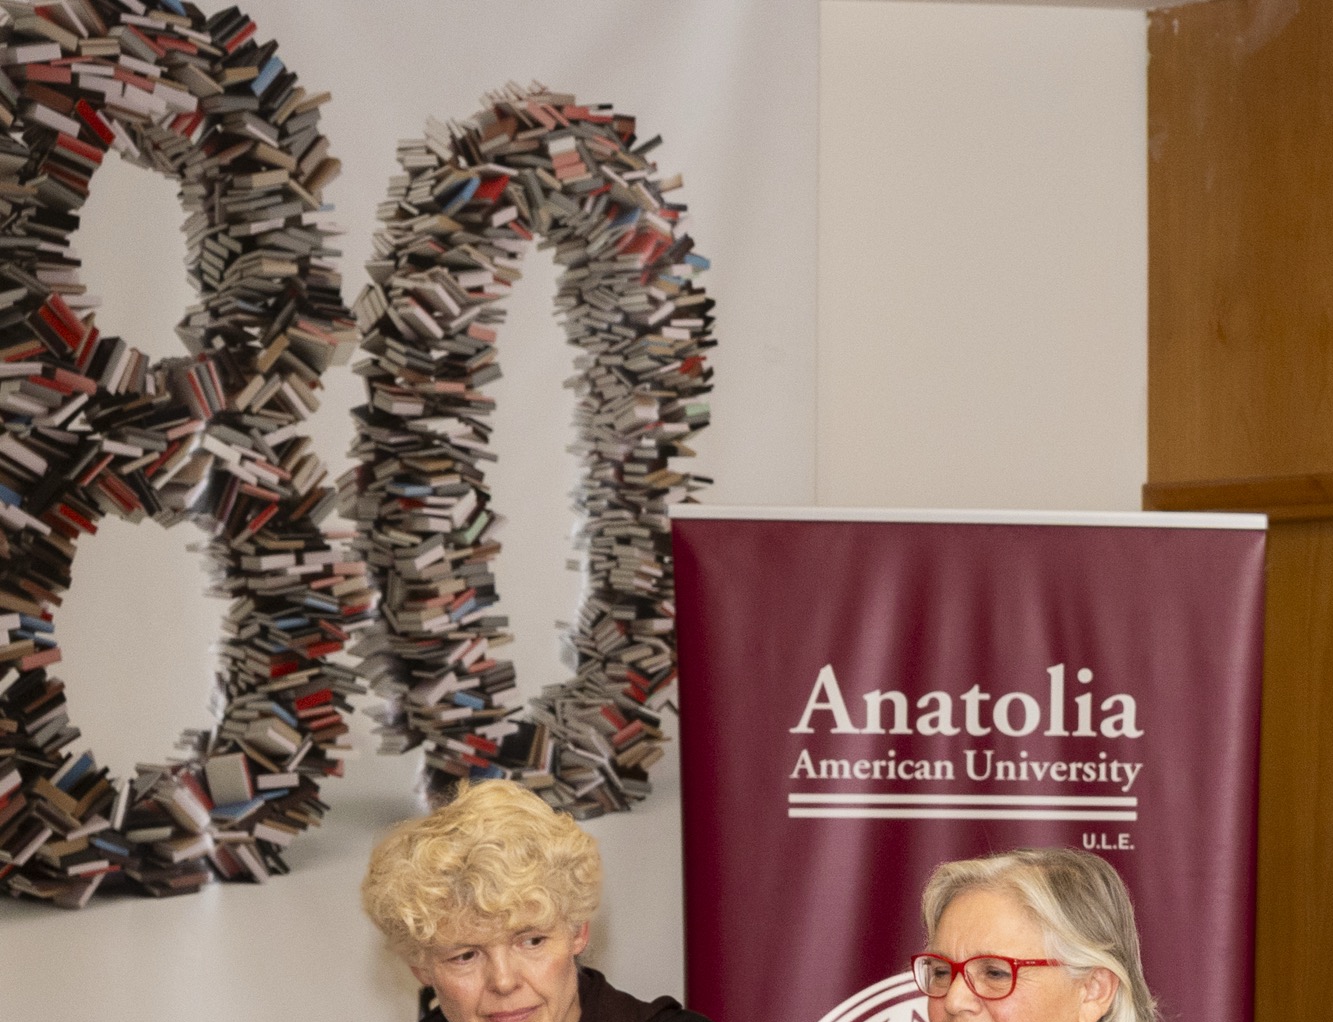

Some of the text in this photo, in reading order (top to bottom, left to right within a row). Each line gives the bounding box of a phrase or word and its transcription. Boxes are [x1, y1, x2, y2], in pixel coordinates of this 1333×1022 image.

[788, 662, 1145, 739] Anatolia
[788, 748, 1143, 793] American University
[1082, 832, 1136, 850] U.L.E.
